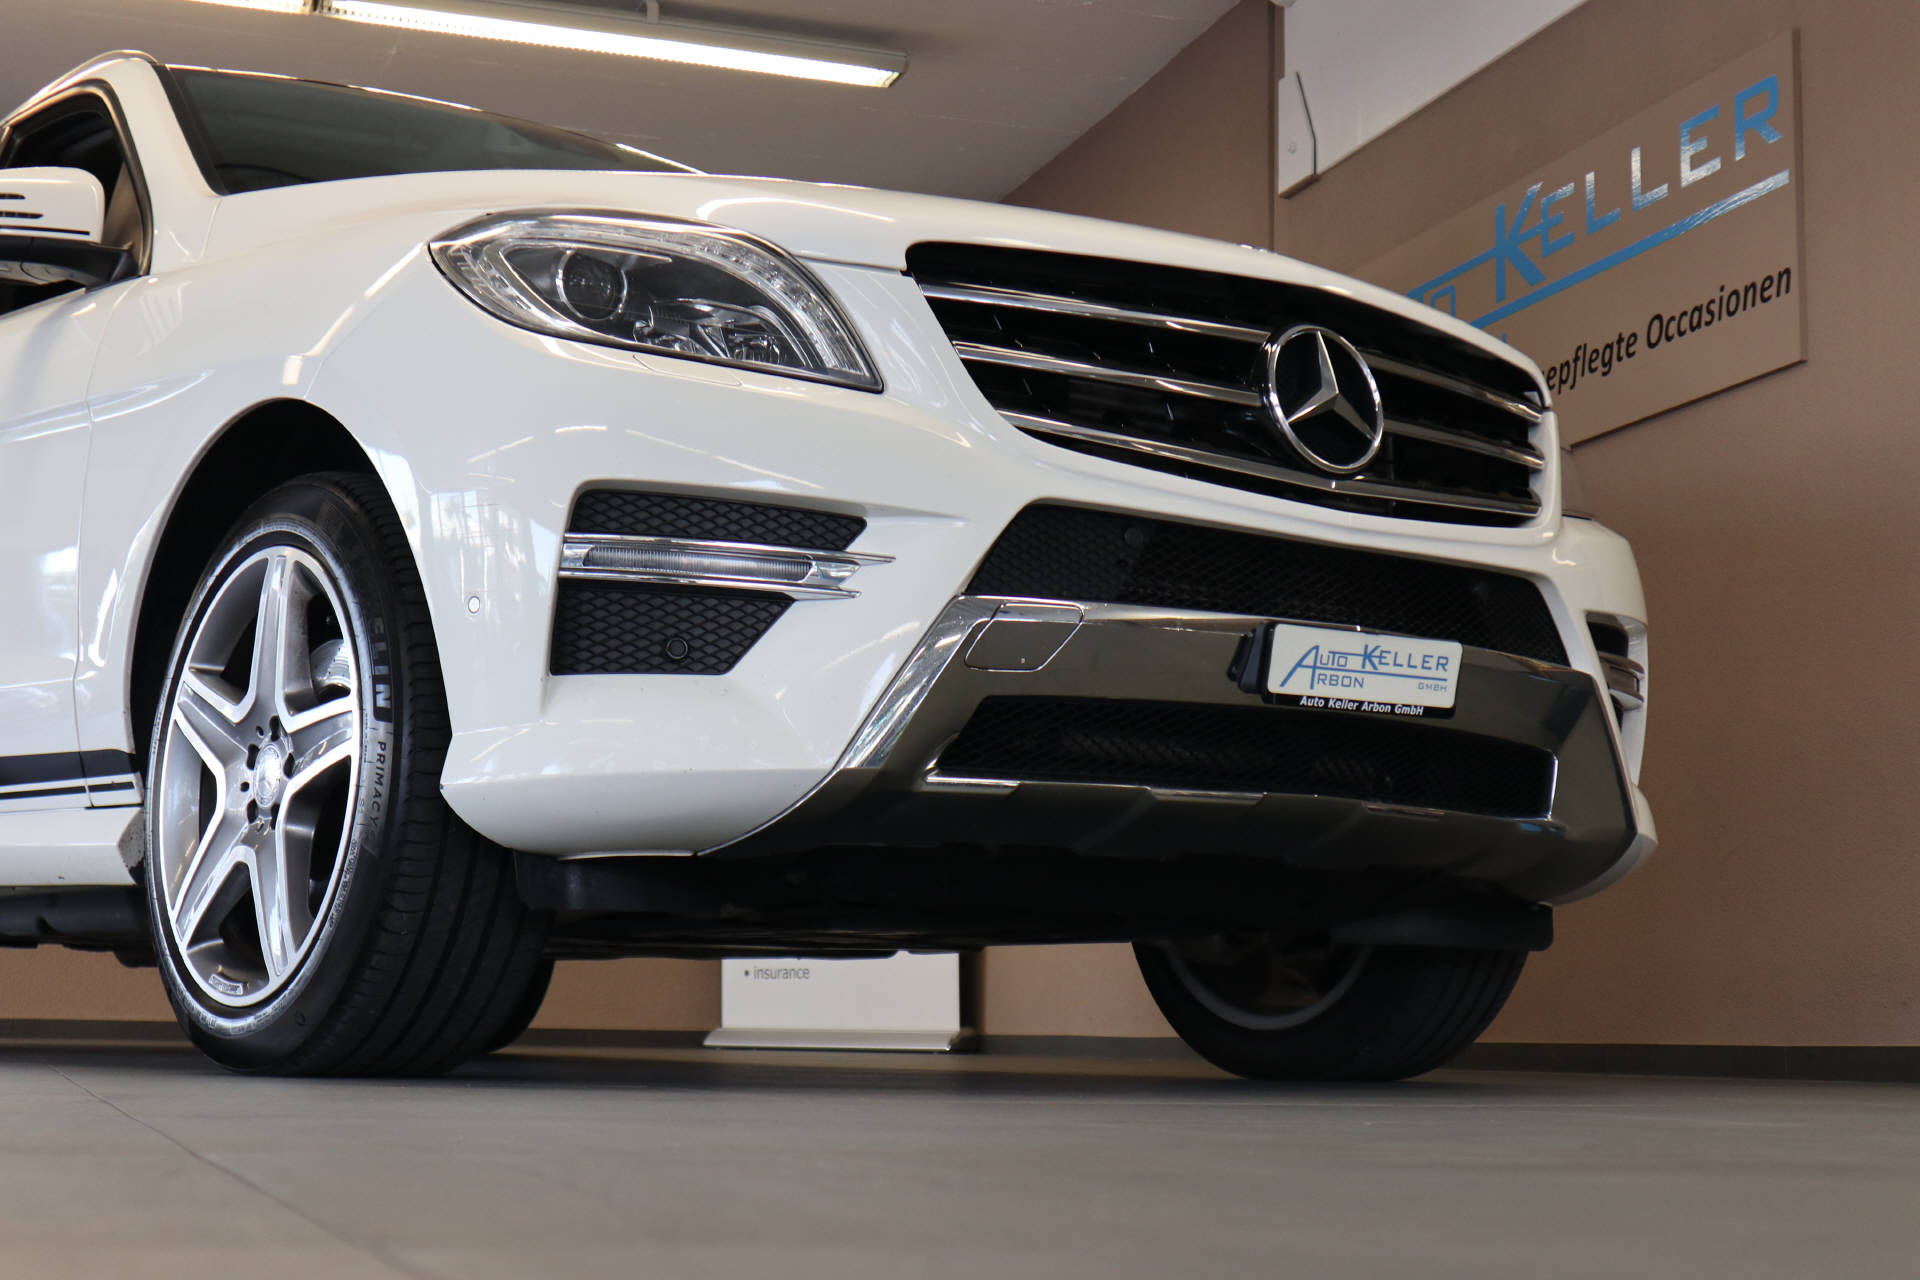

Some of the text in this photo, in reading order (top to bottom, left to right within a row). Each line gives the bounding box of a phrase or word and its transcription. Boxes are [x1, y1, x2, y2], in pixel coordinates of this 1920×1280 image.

[1495, 74, 1783, 303] KELLER
[1542, 265, 1792, 395] epflegte Occasionen
[1279, 643, 1449, 690] AUTO KELLER
[1300, 695, 1424, 716] Auto Keller Arbon GmbH
[369, 741, 387, 826] PRIMACY
[752, 965, 811, 980] insurance
